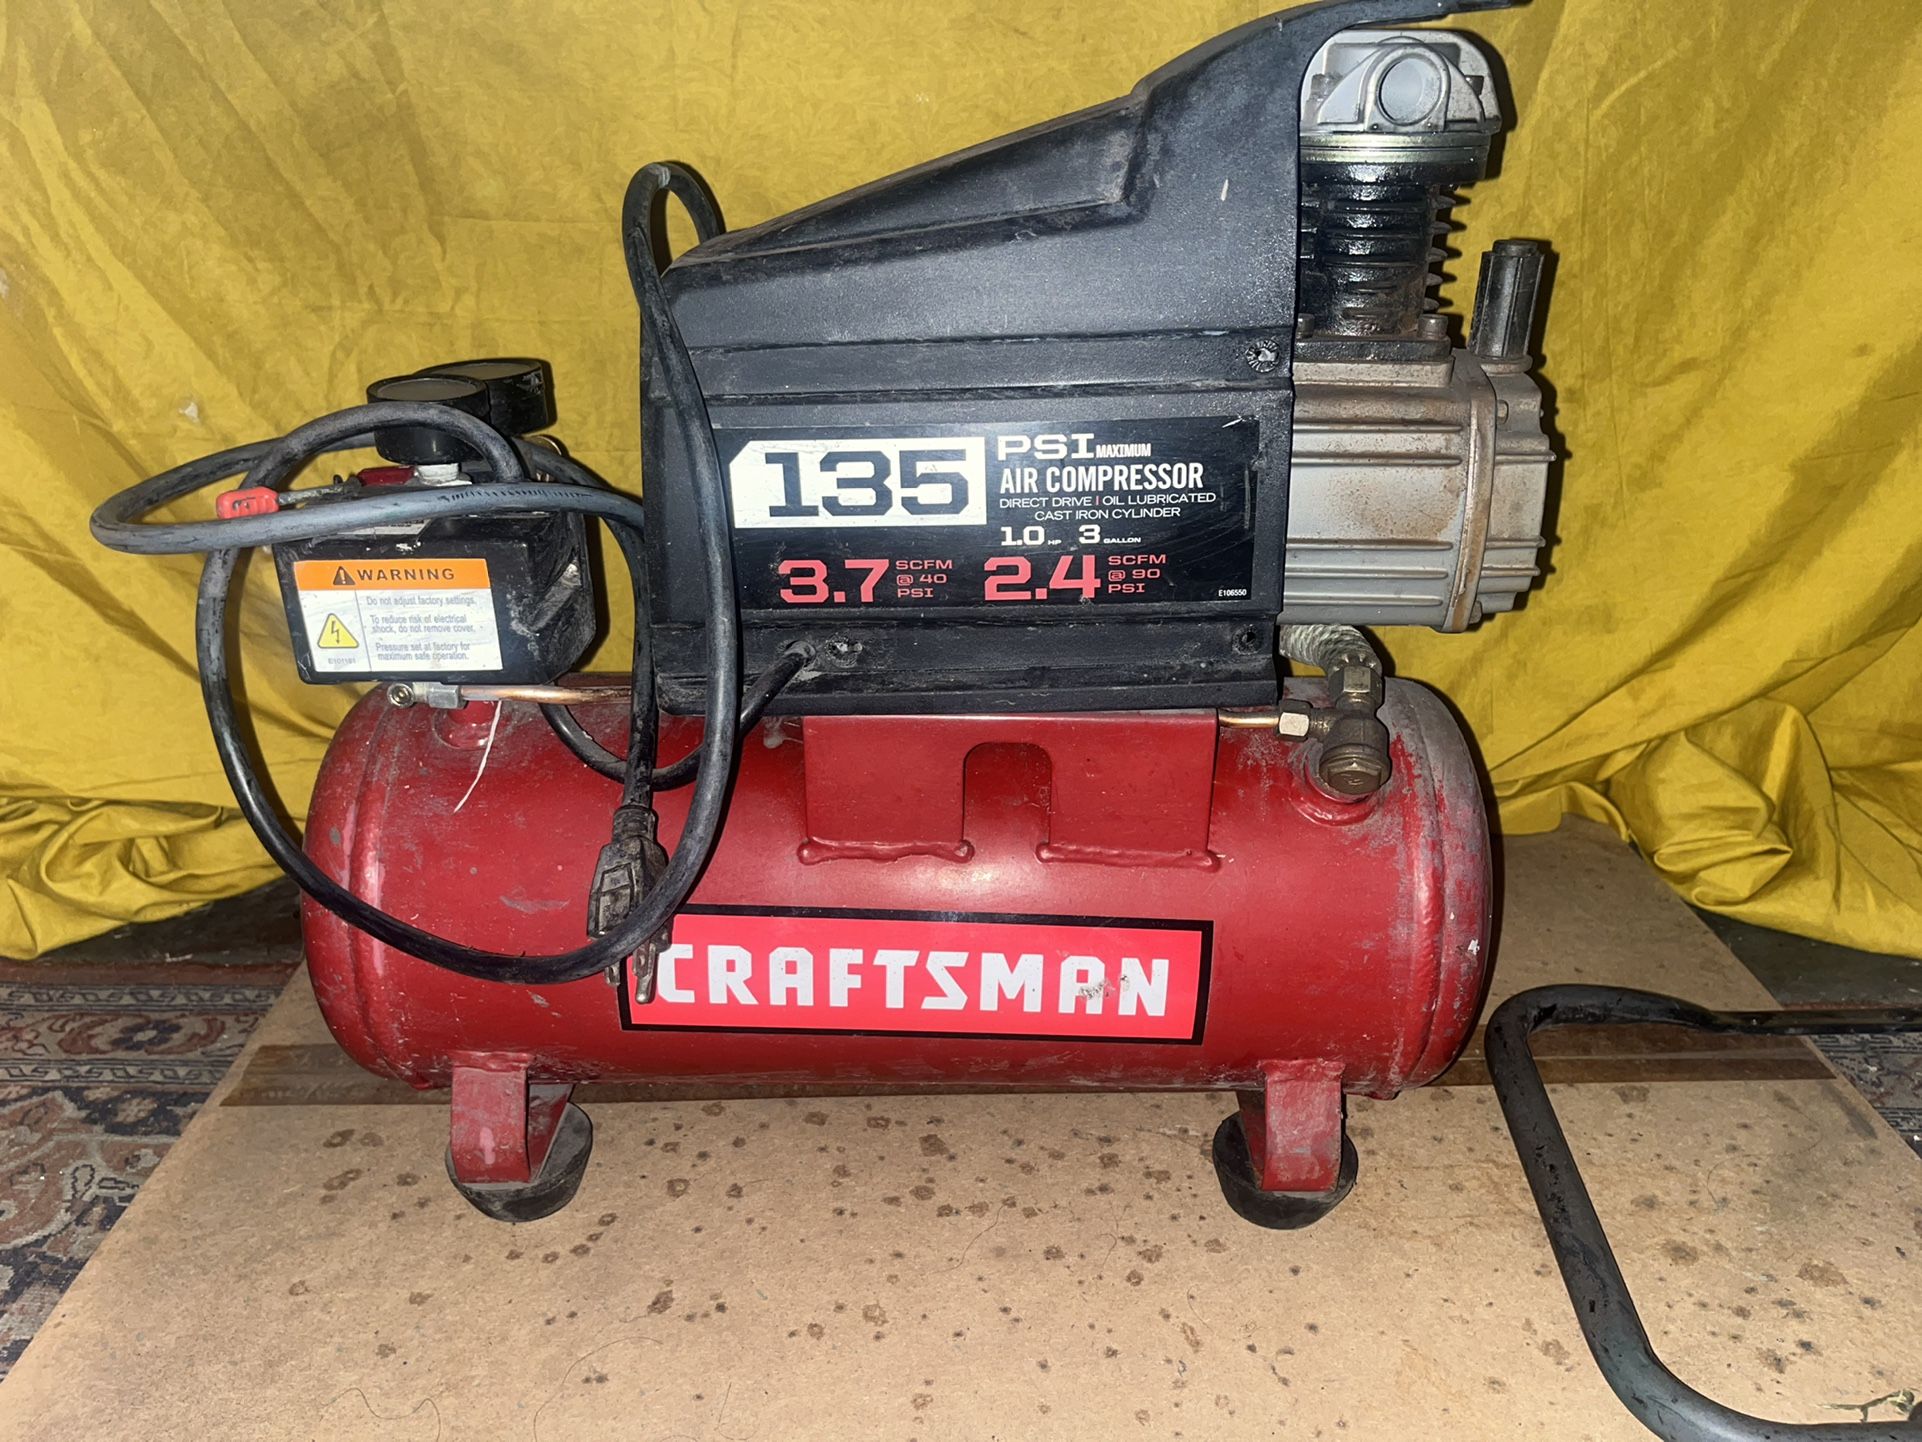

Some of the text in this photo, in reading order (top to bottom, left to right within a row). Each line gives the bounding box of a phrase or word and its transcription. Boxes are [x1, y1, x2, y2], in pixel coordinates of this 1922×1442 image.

[765, 432, 1152, 519] 135 PSI MAXIMUM
[1000, 462, 1204, 494] AIR COMPRESSOR
[1000, 492, 1216, 508] DIRECT DRIVE OIL LUBRICATED
[1034, 507, 1181, 521] CAST IRON CYLINDER
[1000, 525, 1045, 546] 1.0
[1078, 524, 1101, 545] 3
[1103, 536, 1142, 544] GALLON
[357, 567, 455, 581] WARNING
[777, 558, 953, 603] 3.7 SCFM
[896, 573, 947, 586] @ 40
[983, 554, 1167, 601] 2.4 SCFM
[1108, 568, 1161, 582] @ 90
[897, 587, 934, 598] PSI
[1108, 583, 1145, 594] PSI
[1218, 588, 1248, 597] E106550
[366, 594, 477, 608] Do not adjust factory settings.
[369, 613, 467, 624] To reduce risk of electrical
[371, 624, 476, 634] shock, do not remove cover.
[375, 641, 471, 653] Pressure set at factory for
[378, 651, 469, 663] maximum safe operation.
[656, 943, 1169, 1017] CRAFTSMAN
